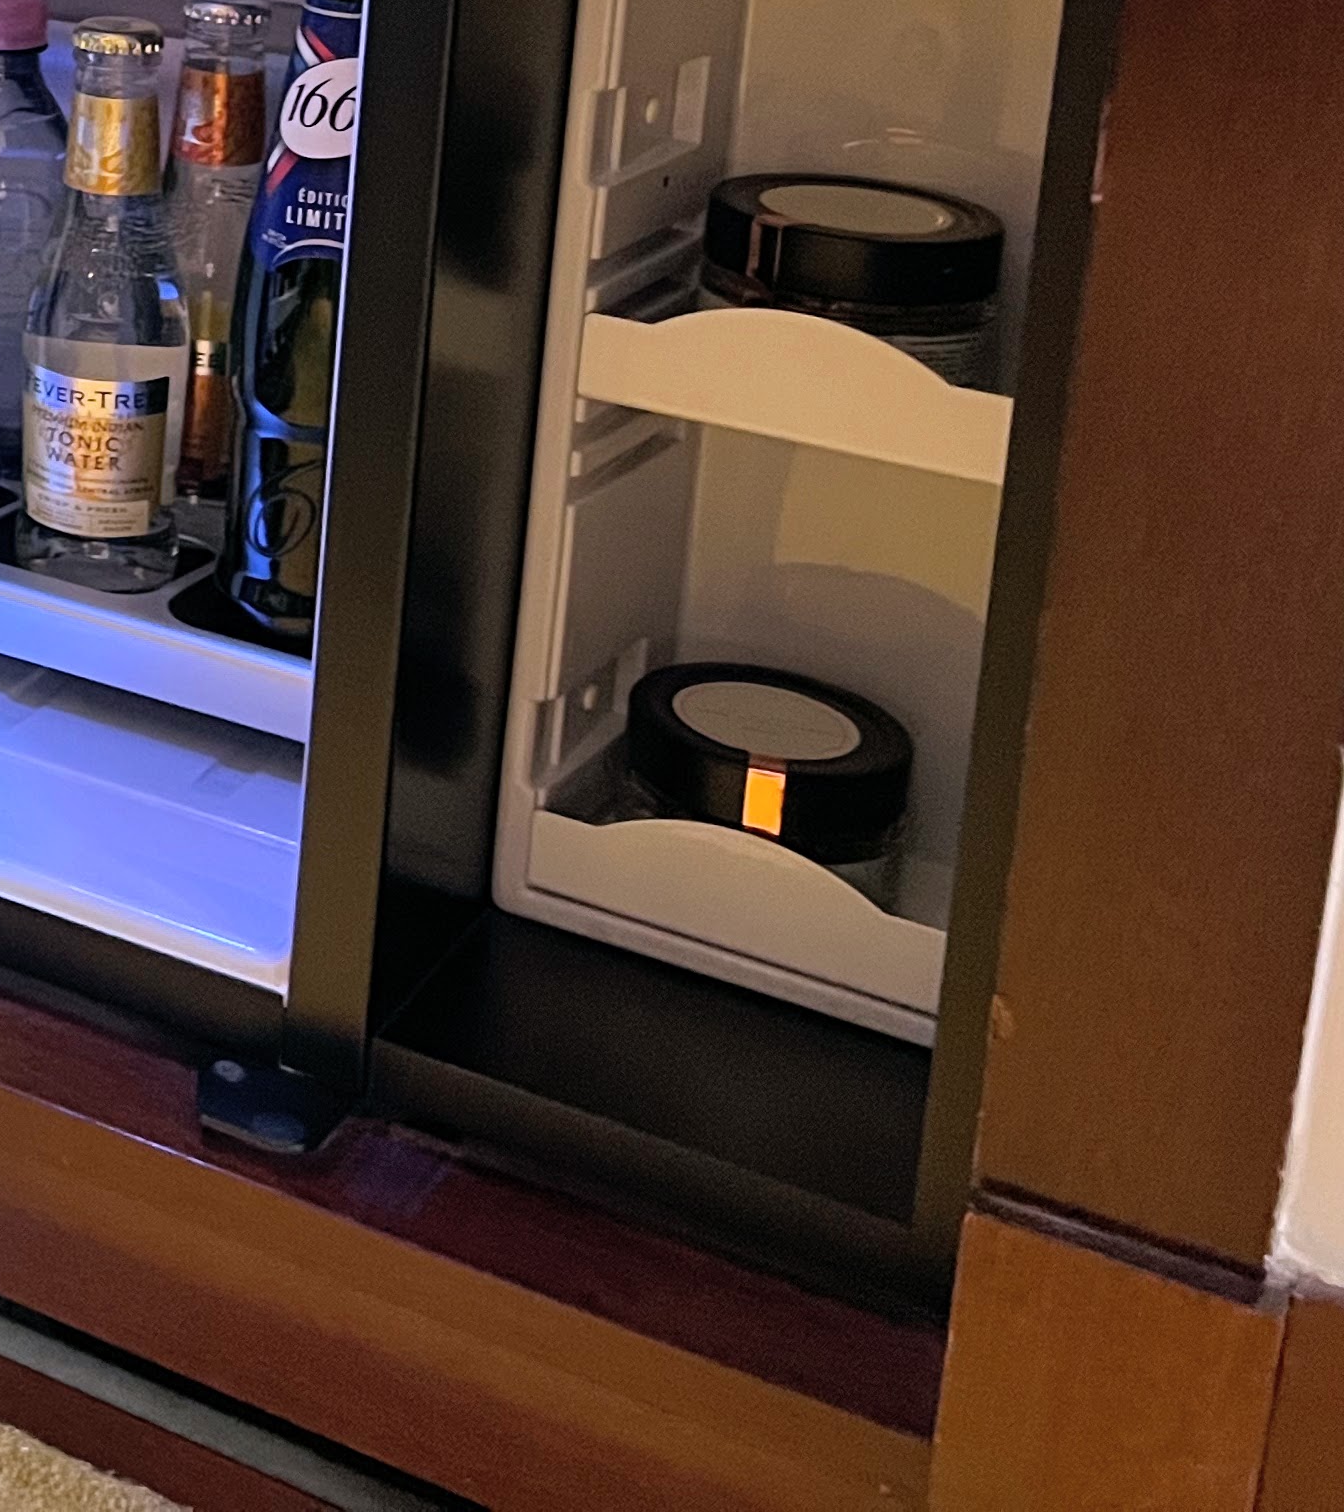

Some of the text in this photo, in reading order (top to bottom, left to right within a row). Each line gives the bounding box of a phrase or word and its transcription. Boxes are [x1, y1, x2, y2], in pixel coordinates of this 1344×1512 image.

[287, 77, 358, 133] 166
[298, 187, 349, 208] ÉDITIO
[285, 204, 346, 231] LIMIT
[26, 368, 146, 410] FEVER-TRE
[46, 426, 120, 453] TONIC
[46, 445, 122, 472] WATER
